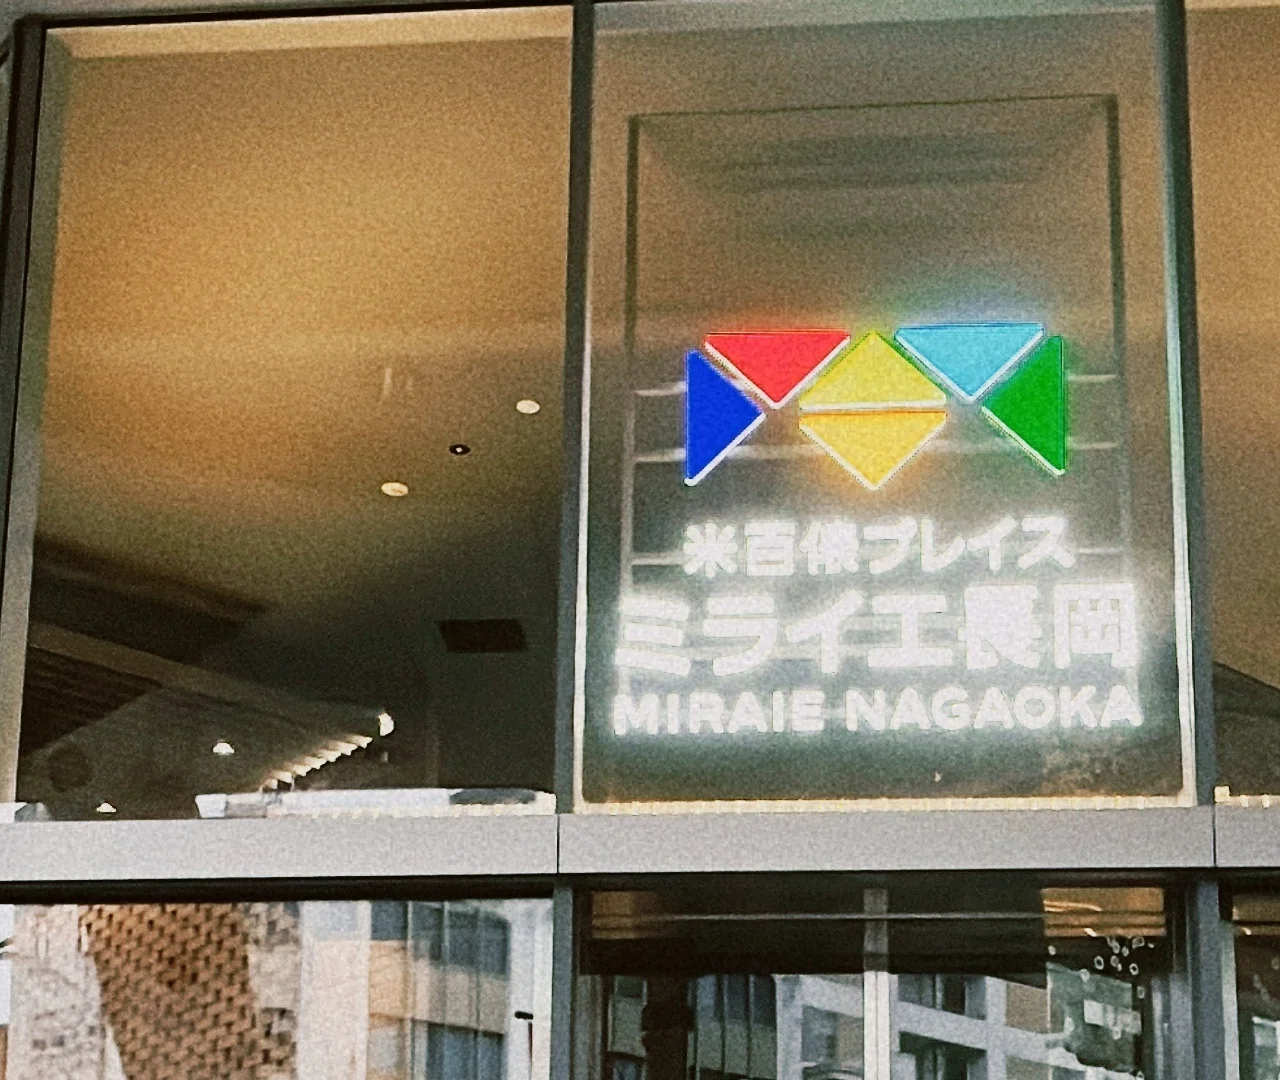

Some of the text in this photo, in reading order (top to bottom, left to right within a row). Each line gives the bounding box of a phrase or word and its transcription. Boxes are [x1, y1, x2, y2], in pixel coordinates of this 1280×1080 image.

[615, 582, 1136, 677] ミライエ長岡
[613, 685, 1144, 735] MIRAIE NAGAOKA
